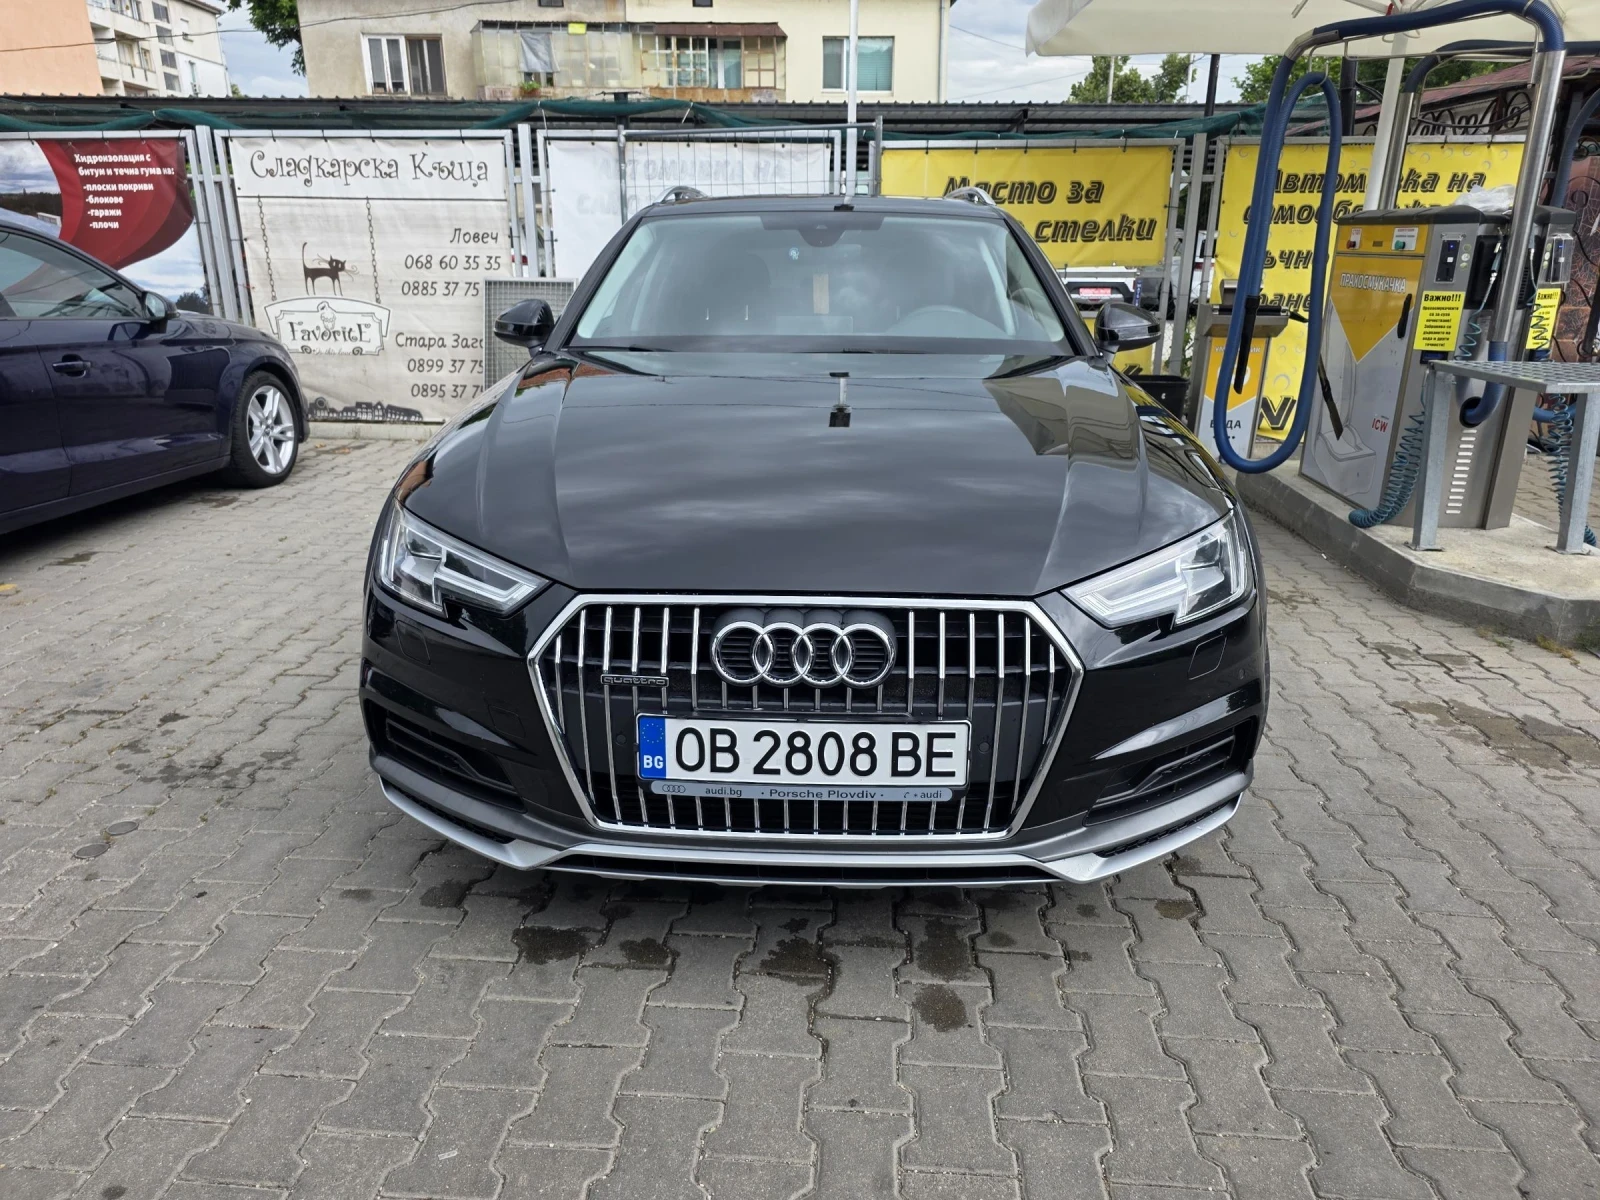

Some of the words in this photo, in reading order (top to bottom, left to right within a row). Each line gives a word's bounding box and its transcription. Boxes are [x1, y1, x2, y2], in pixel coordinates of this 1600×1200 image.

[74, 153, 145, 164] Хидроизолация
[145, 154, 151, 162] с
[78, 166, 105, 178] битум
[113, 167, 139, 176] течна
[140, 167, 162, 177] гума
[250, 149, 399, 187] Сладкарска
[410, 152, 489, 187] Къща
[118, 183, 154, 192] покриви
[1447, 171, 1487, 193] на
[85, 194, 124, 204] -блокове
[1066, 179, 1105, 204] за
[87, 208, 122, 218] -гаражи
[89, 221, 119, 229] -плочи
[1034, 213, 1158, 243] стелки
[449, 227, 499, 244] Ловеч
[404, 254, 433, 270] 068
[439, 254, 458, 270] 60
[463, 255, 481, 270] 35
[484, 255, 501, 271] 35
[401, 280, 438, 296] 0885
[442, 281, 460, 297] 37
[464, 281, 480, 297] 75
[1340, 273, 1407, 294] ПРАХОСМУКАЧКА
[1423, 293, 1462, 302] Важно!!!
[288, 320, 371, 343] FavoritE
[395, 332, 447, 351] Стара
[407, 358, 444, 373] 0899
[448, 359, 465, 374] 37
[411, 383, 446, 398] 0895
[450, 384, 467, 399] 37
[472, 385, 484, 399] 7
[1210, 420, 1242, 430] ДА
[1371, 417, 1389, 433] ICW
[603, 676, 666, 685] quattro
[643, 754, 664, 770] BG
[674, 727, 740, 774] OB
[752, 729, 878, 777] 2808
[891, 731, 957, 779] BE
[705, 786, 742, 797] audi.bg
[769, 788, 823, 799] Porsche
[827, 789, 877, 799] Plovdiv
